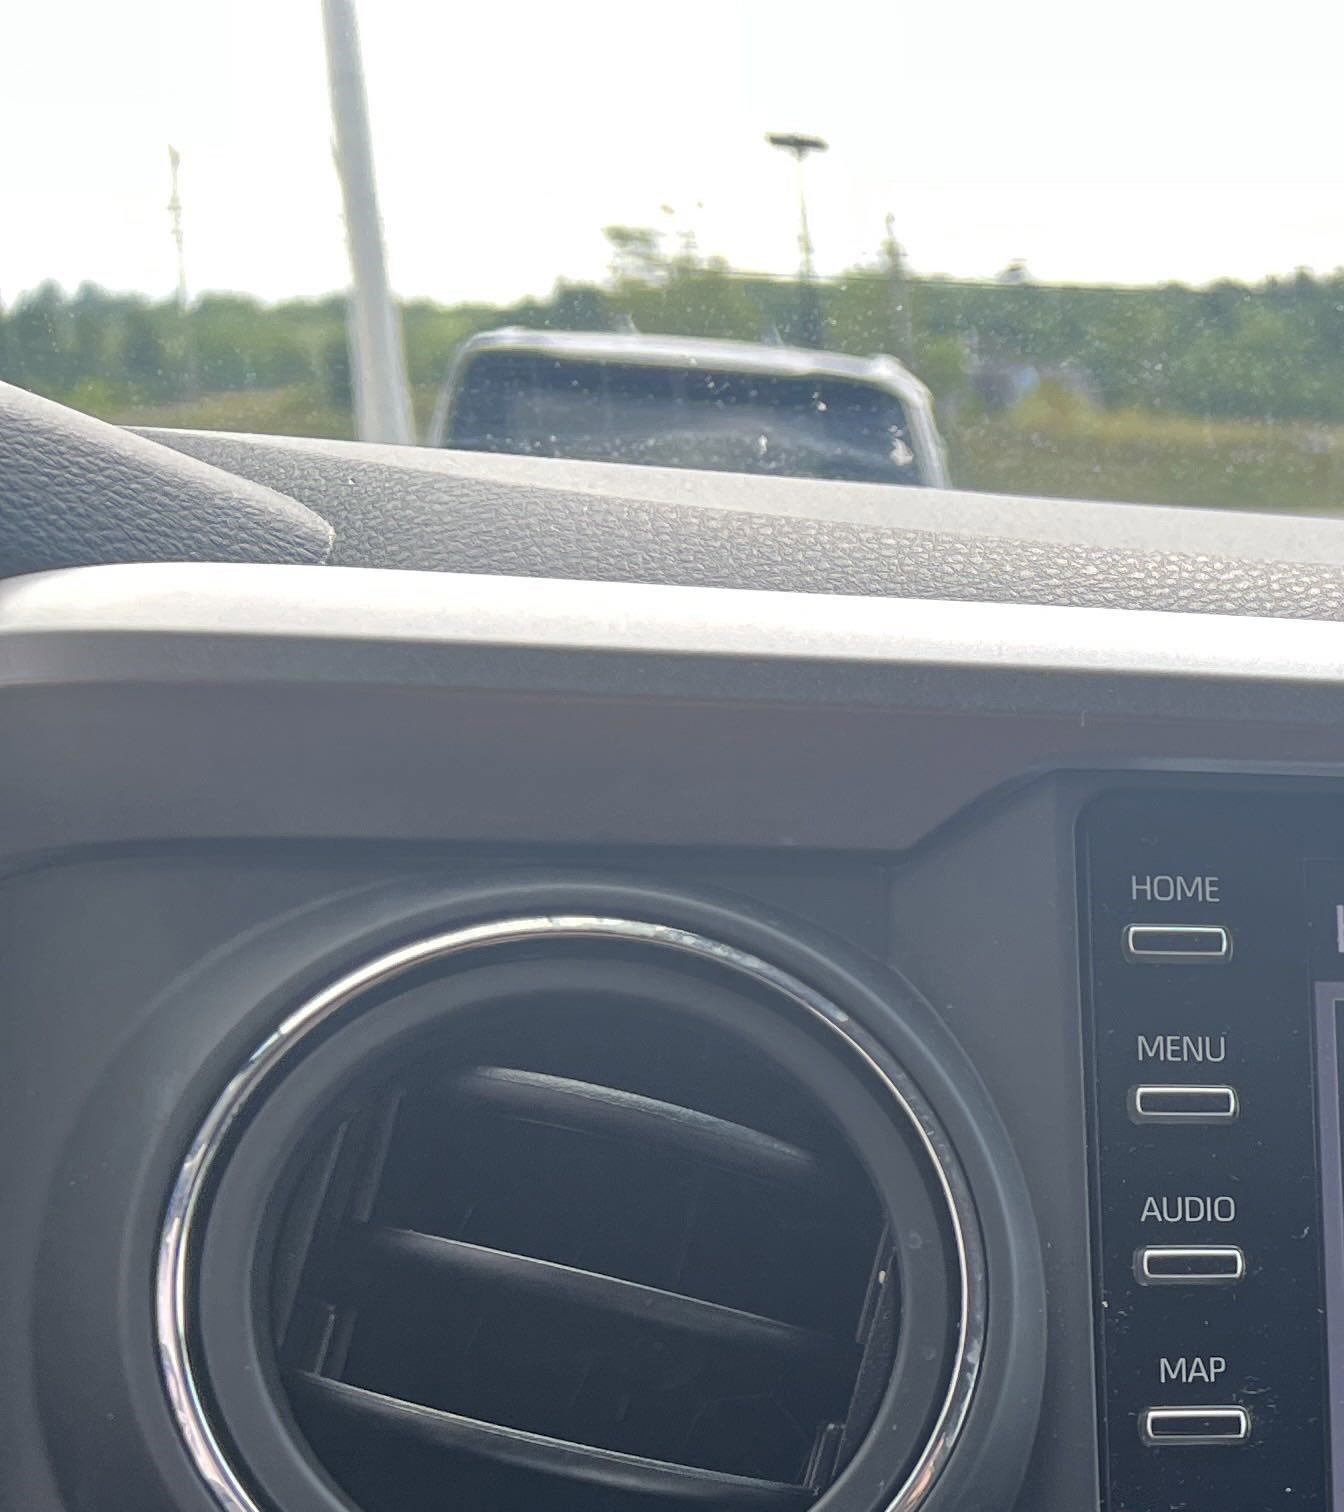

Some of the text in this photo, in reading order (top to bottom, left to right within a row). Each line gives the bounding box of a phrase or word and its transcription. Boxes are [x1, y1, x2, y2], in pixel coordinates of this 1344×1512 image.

[1130, 874, 1221, 903] HOME
[1136, 1035, 1226, 1063] MENU
[1140, 1195, 1236, 1224] AUDIO
[1159, 1355, 1227, 1385] MAP
